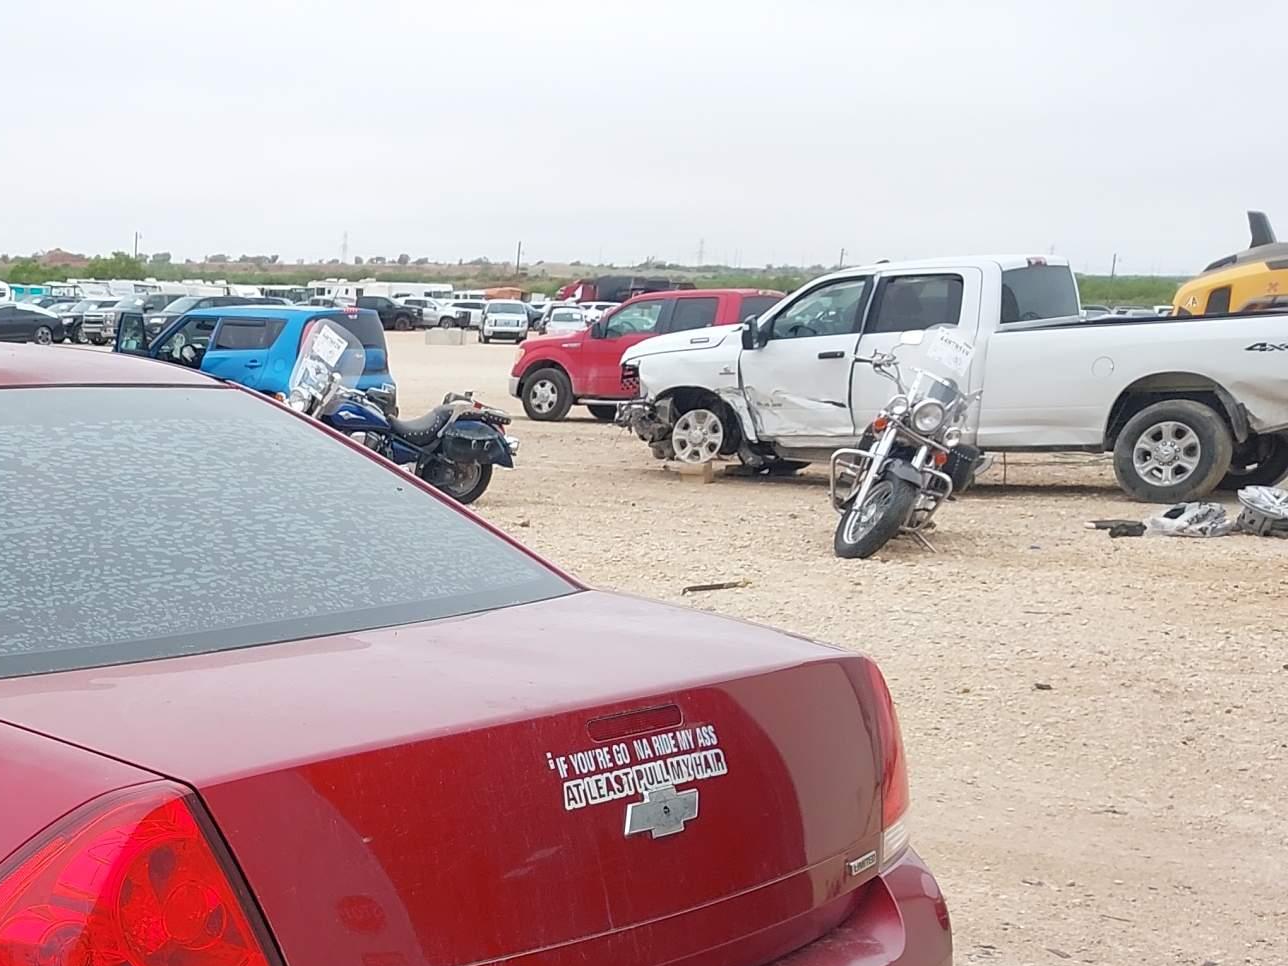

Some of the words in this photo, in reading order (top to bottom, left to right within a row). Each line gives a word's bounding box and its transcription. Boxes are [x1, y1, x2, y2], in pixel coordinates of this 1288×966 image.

[556, 756, 568, 778] IF
[569, 747, 614, 775] YOU'RE
[651, 732, 678, 756] RIDE
[677, 729, 694, 751] MY
[695, 725, 718, 747] ASS
[565, 782, 585, 808] AT
[588, 770, 633, 801] LEAST
[636, 762, 670, 791] PULL
[670, 756, 695, 782] MY
[693, 751, 726, 777] HAIR
